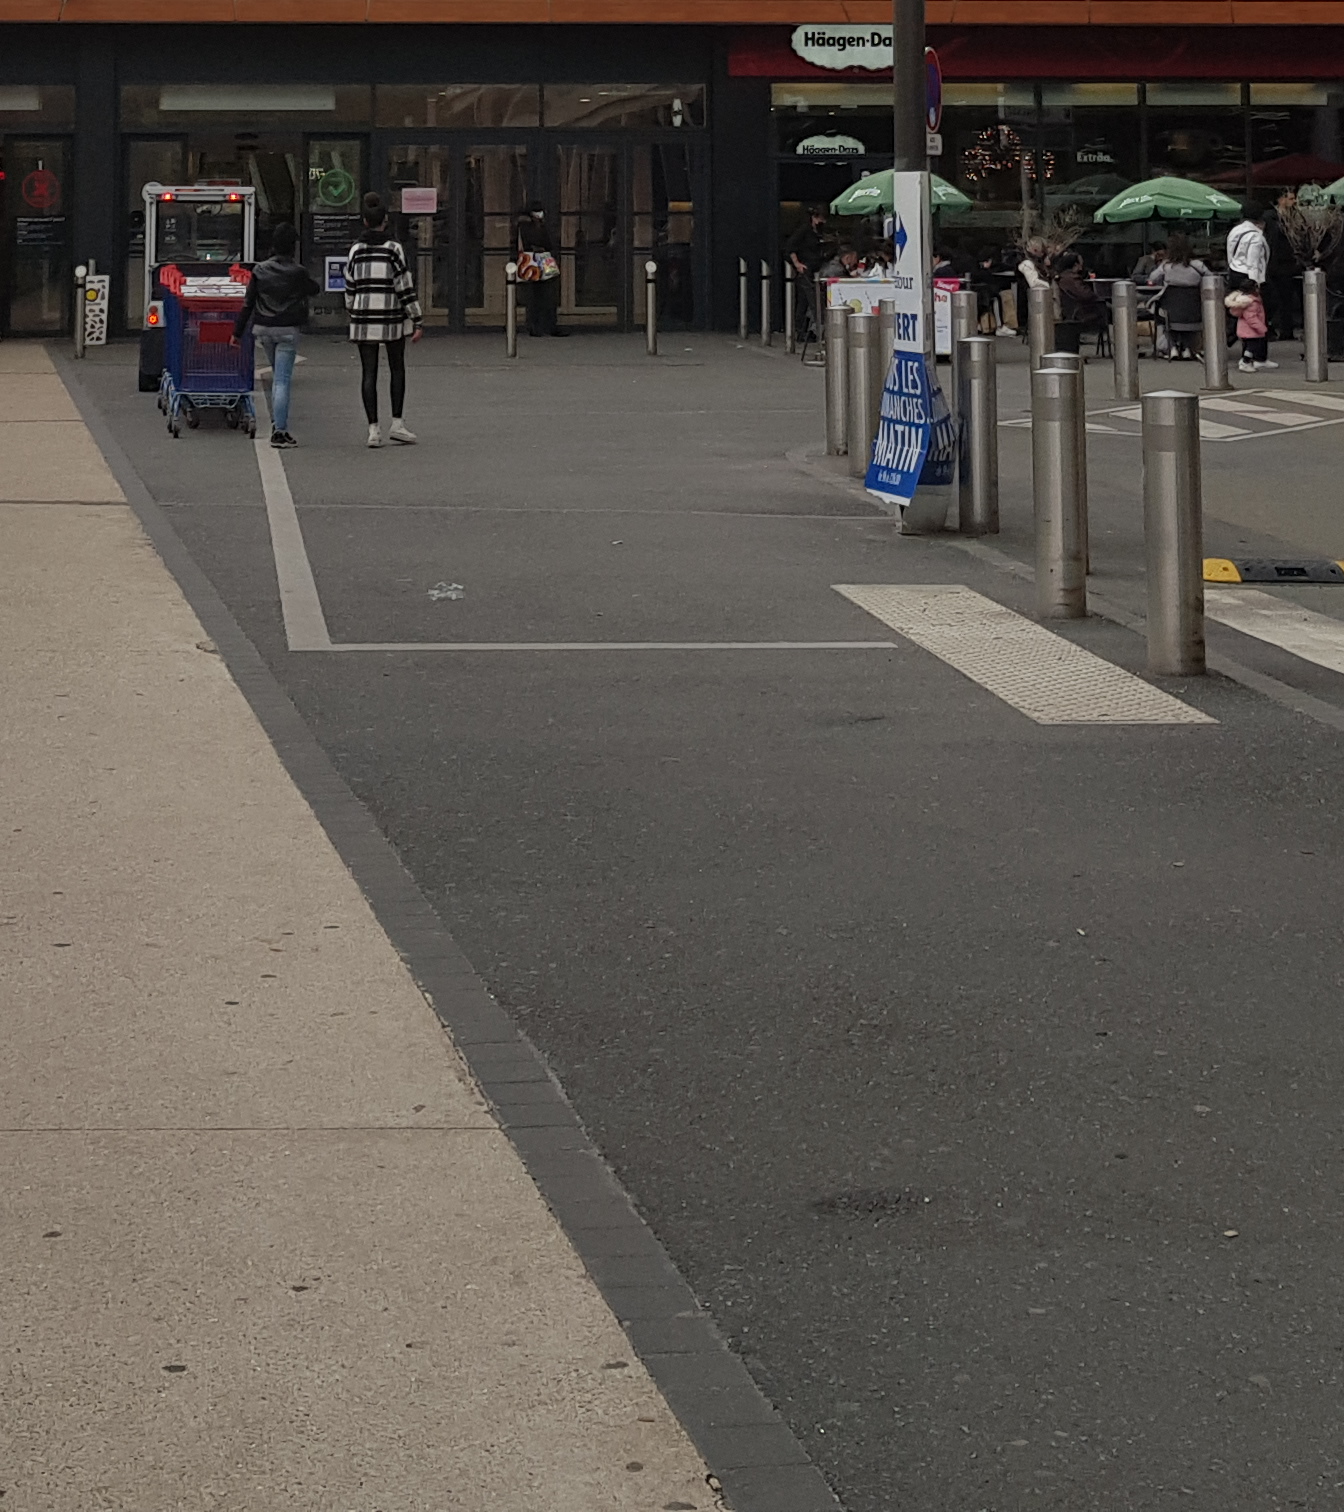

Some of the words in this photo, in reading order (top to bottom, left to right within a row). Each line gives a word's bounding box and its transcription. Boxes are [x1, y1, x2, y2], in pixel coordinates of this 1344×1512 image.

[804, 31, 893, 51] Häagen-Da
[895, 313, 918, 342] ERT
[901, 360, 922, 395] LES
[872, 420, 924, 473] MATIN
